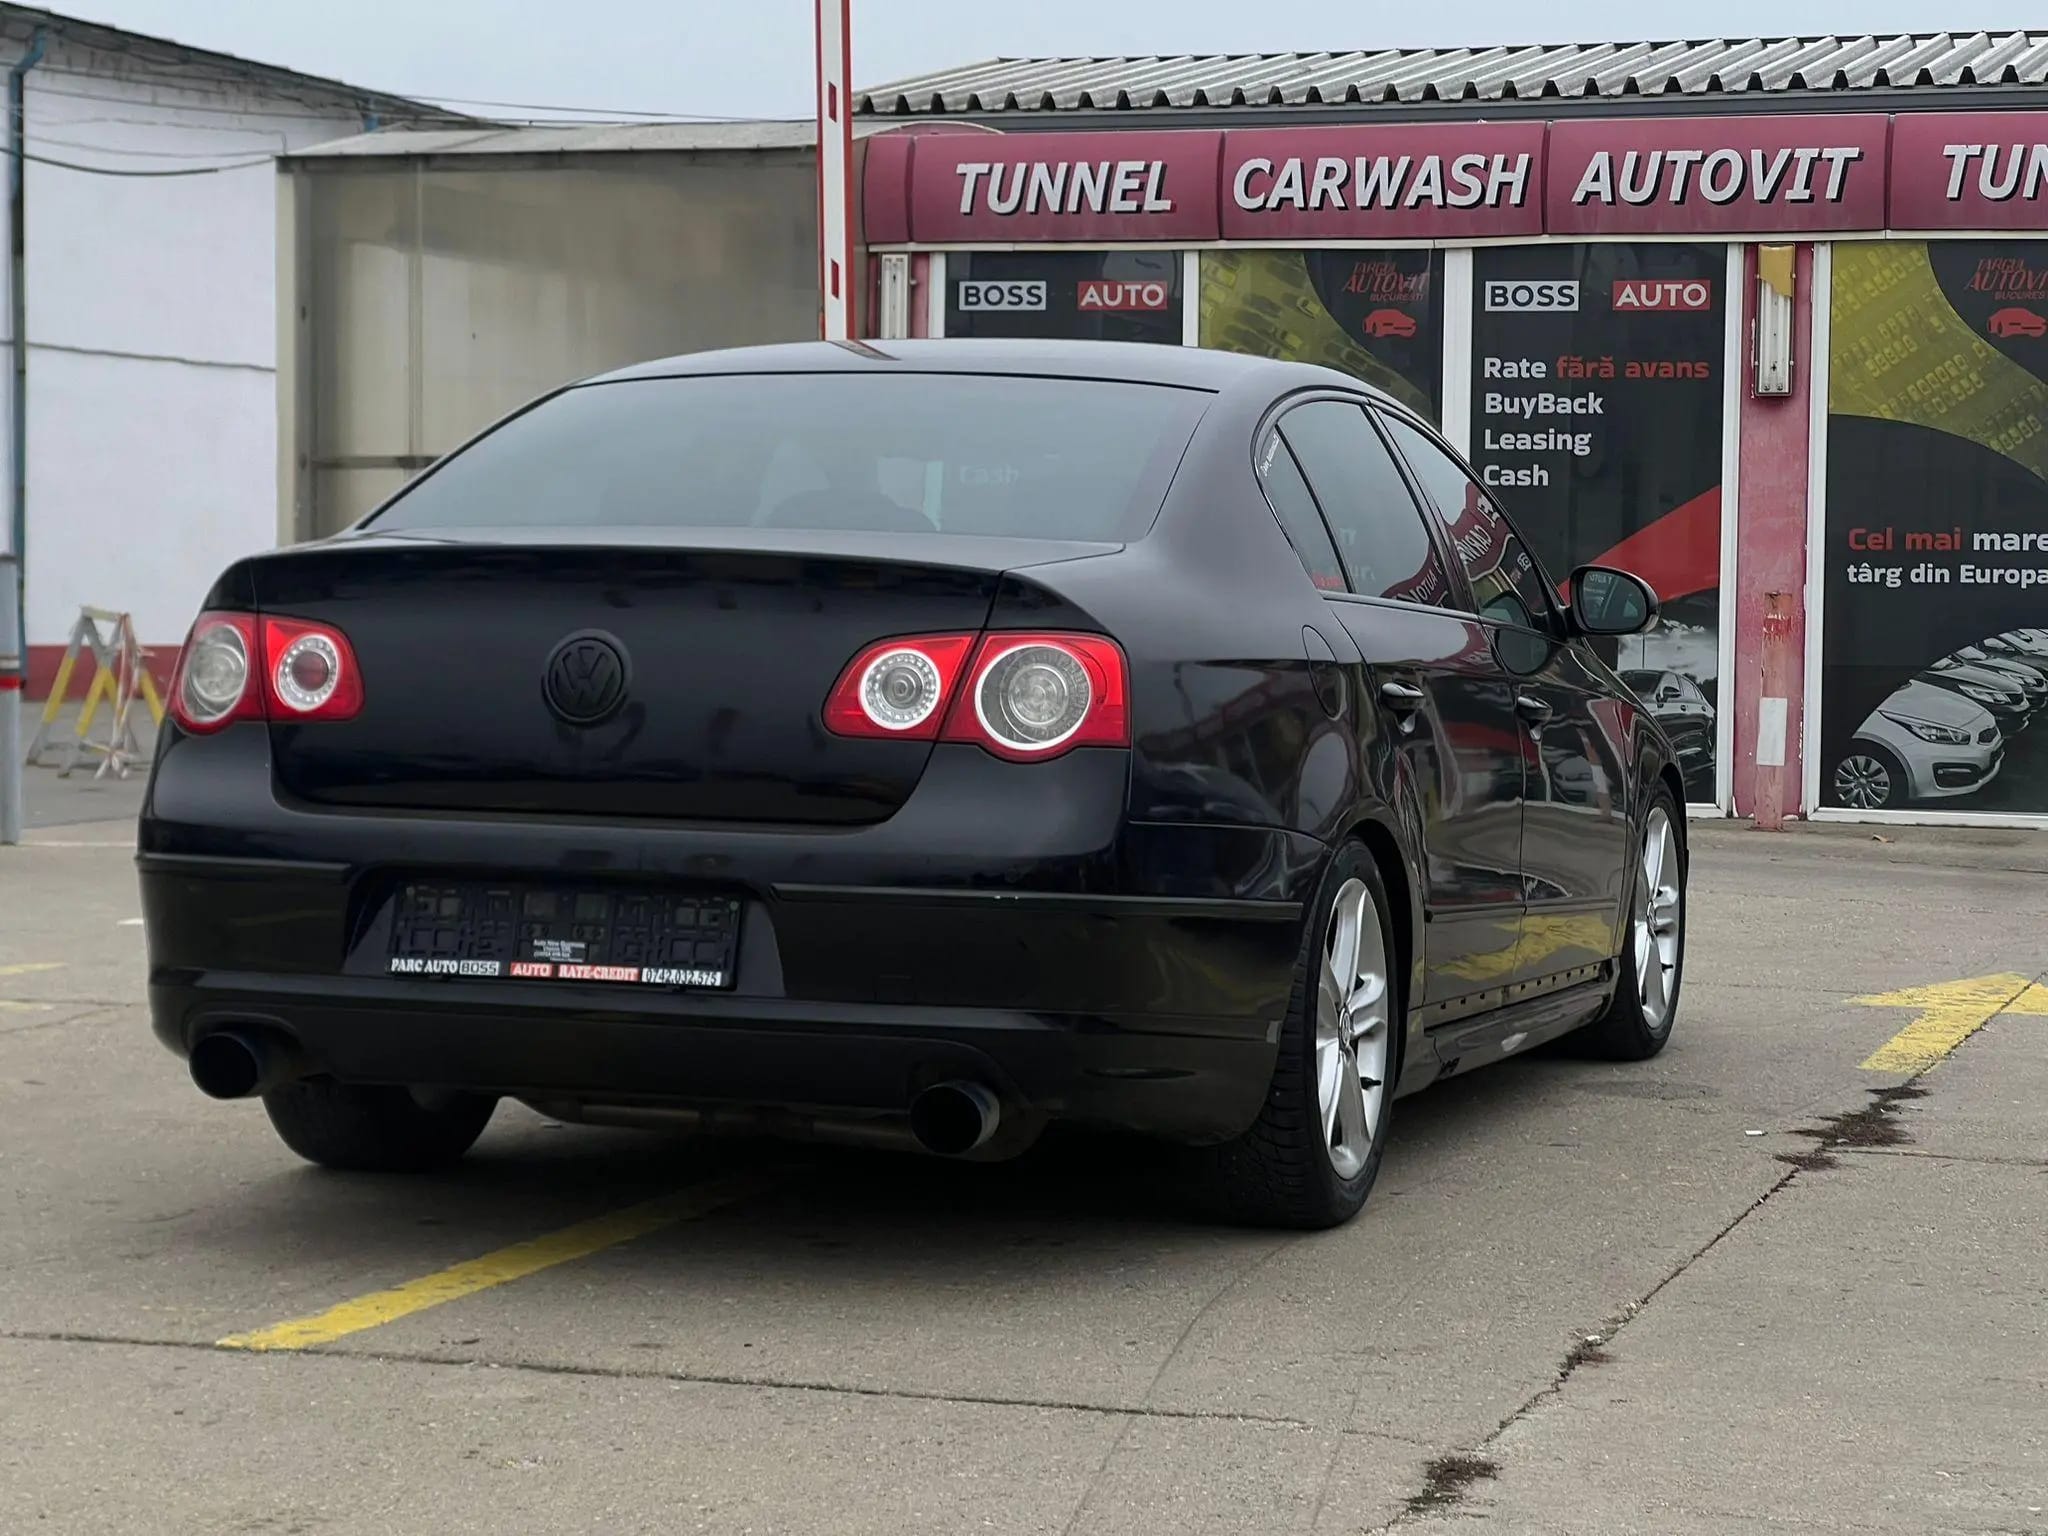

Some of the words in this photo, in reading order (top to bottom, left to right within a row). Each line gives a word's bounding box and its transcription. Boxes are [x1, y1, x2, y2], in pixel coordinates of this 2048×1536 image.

[957, 161, 1174, 214] TUNNEL
[1233, 152, 1531, 211] CARWASH
[1572, 147, 1861, 203] AUTOVIT
[1943, 144, 2048, 199] TUN
[963, 283, 1042, 307] BOSS
[1080, 283, 1165, 308] AUTO
[1490, 285, 1576, 307] BOSS
[1615, 284, 1708, 308] AUTO
[1484, 357, 1547, 379] Rate
[1556, 355, 1616, 379] fără
[1624, 360, 1710, 379] avans
[1484, 392, 1604, 419] BuyBack
[1484, 428, 1593, 456] Leasing
[1484, 464, 1550, 487] Cash
[1848, 527, 1894, 551] Cel
[1904, 527, 1962, 551] mai
[1973, 532, 2048, 551] mare
[1846, 562, 1903, 587] târg
[1909, 563, 1950, 584] din
[1960, 564, 2048, 589] Europa
[391, 957, 423, 972] PARC
[424, 959, 459, 974] AUTO
[460, 961, 498, 975] BOSS
[513, 963, 549, 977] AUTO
